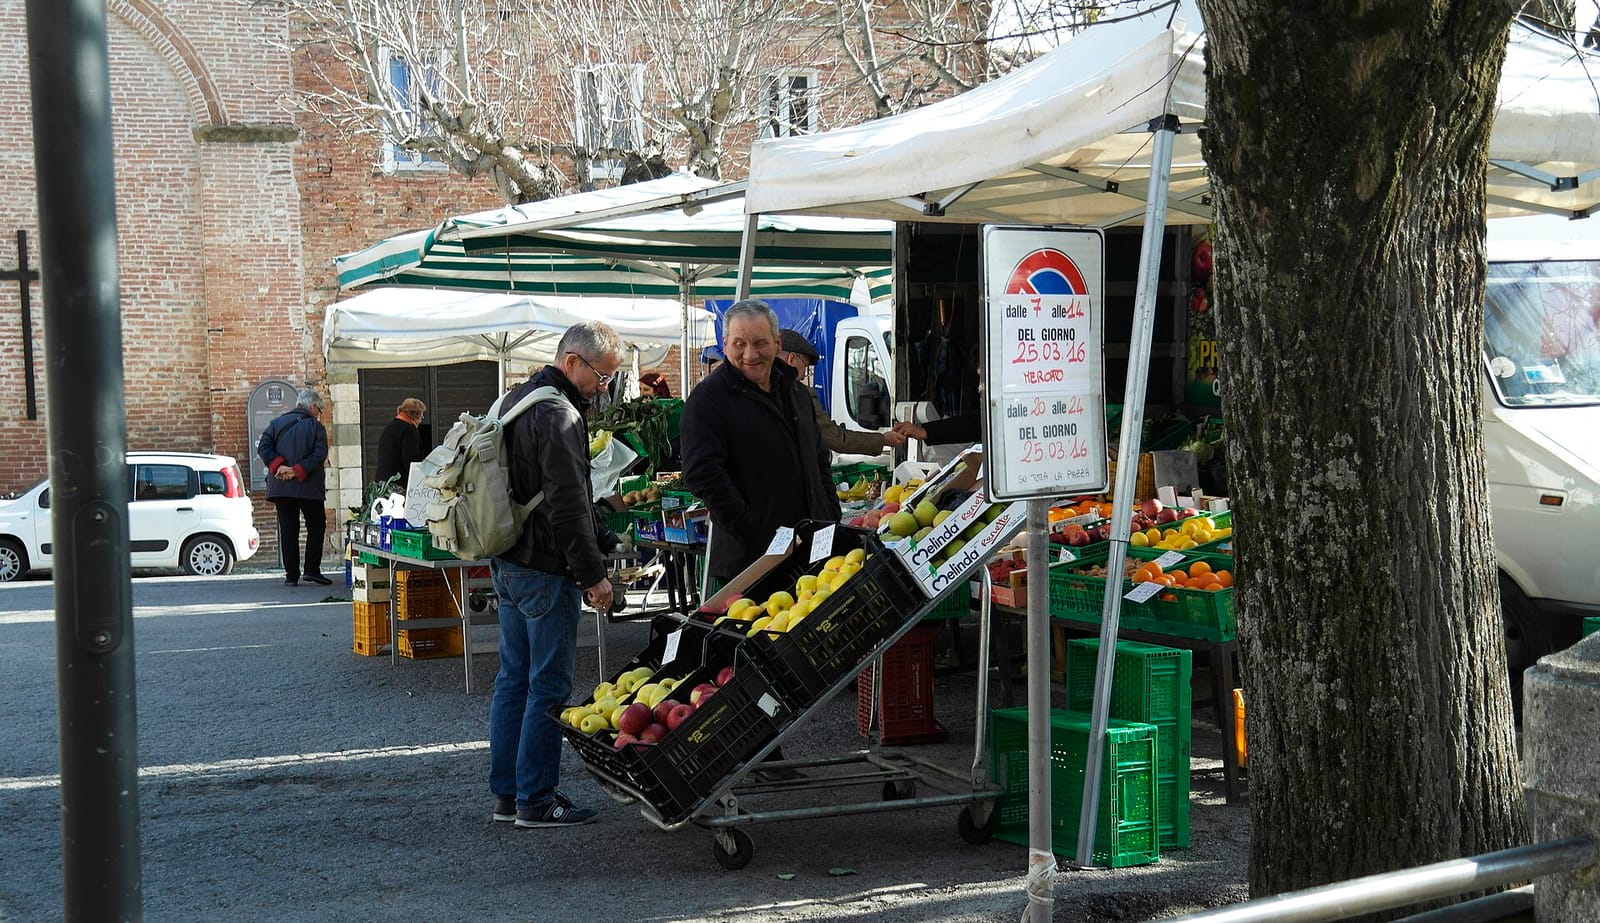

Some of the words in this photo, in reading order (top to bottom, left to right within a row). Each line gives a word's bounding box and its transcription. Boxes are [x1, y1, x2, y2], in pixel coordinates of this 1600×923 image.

[1006, 304, 1028, 319] dalle
[1031, 297, 1042, 318] 7
[1052, 304, 1067, 319] alle
[1066, 298, 1085, 319] 14
[1018, 328, 1036, 341] DEL
[1041, 328, 1076, 341] GIORNO
[1200, 340, 1219, 368] PR
[1212, 378, 1222, 397] Q
[1007, 404, 1028, 419] dalle
[1030, 396, 1046, 417] 20
[1052, 400, 1067, 415] alle
[1068, 395, 1085, 415] 24
[1019, 427, 1038, 441] DEL
[1042, 423, 1078, 439] GIORNO
[911, 522, 960, 566] Melinda
[961, 492, 984, 521] Renett
[932, 551, 980, 592] Melinda
[981, 514, 1011, 547] Renetta
